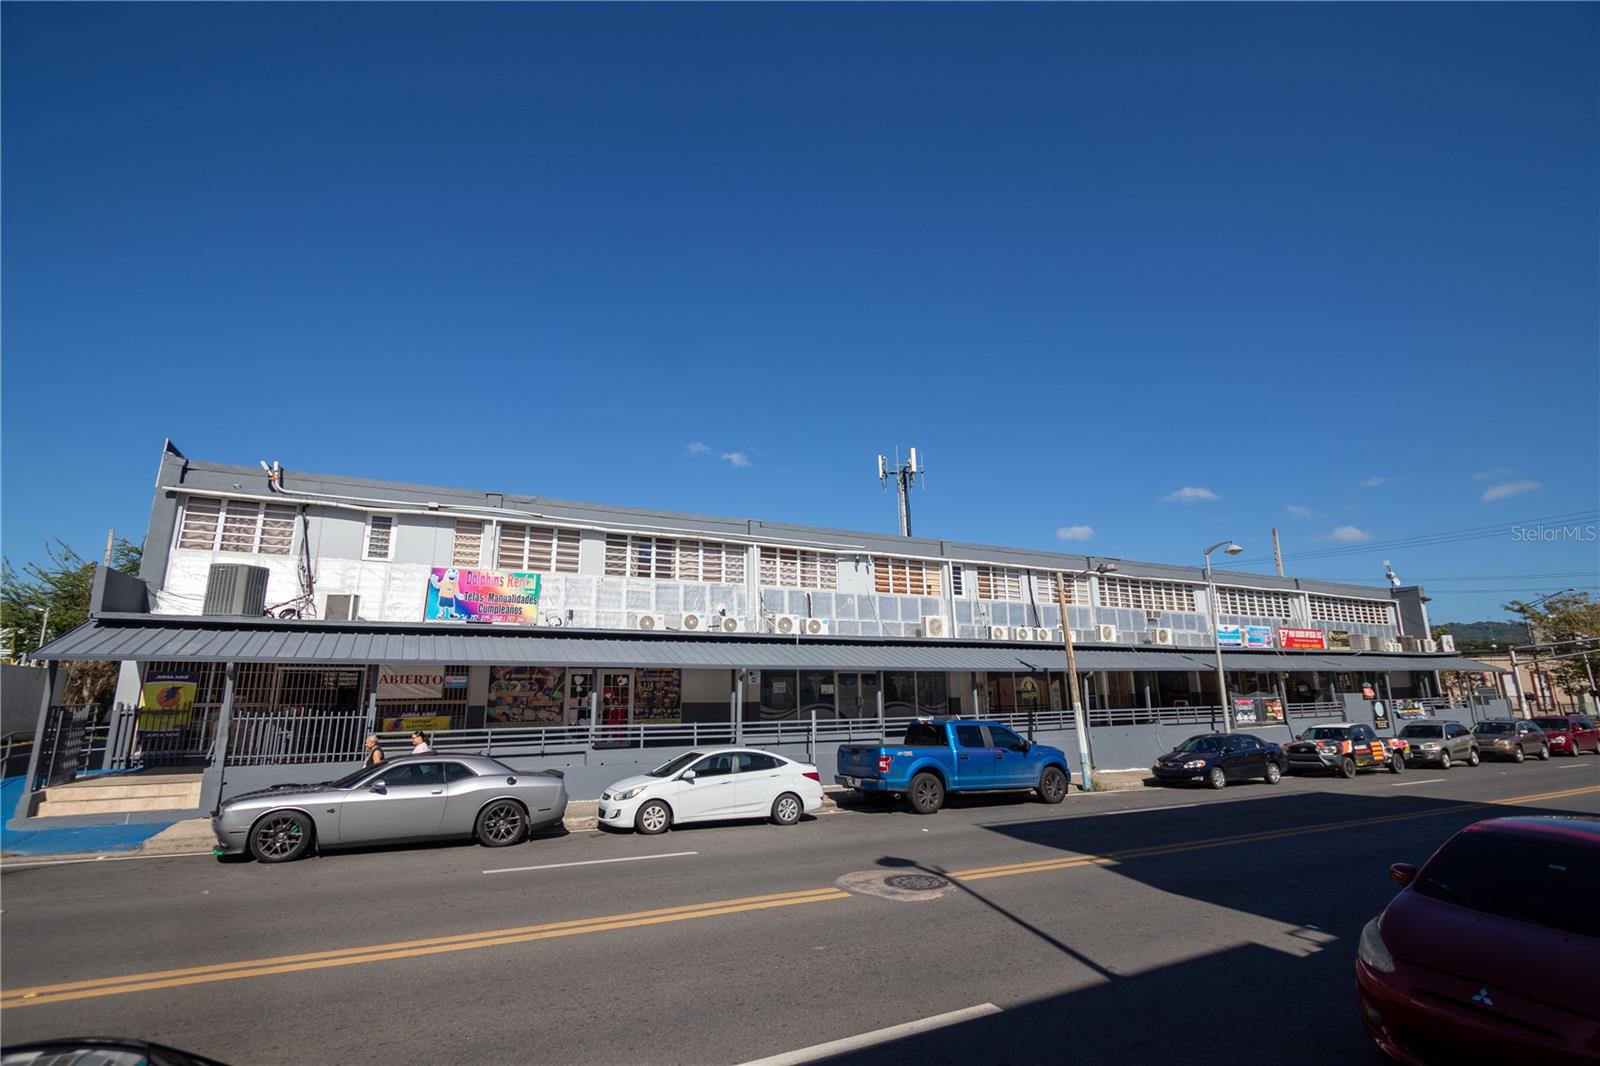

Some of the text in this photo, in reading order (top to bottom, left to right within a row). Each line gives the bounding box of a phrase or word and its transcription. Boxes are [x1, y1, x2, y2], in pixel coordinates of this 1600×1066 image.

[466, 570, 505, 587] Dolphins
[464, 592, 538, 604] Telas Manualidades
[478, 603, 523, 615] Cumpleaños
[379, 674, 443, 685] ABIERTO
